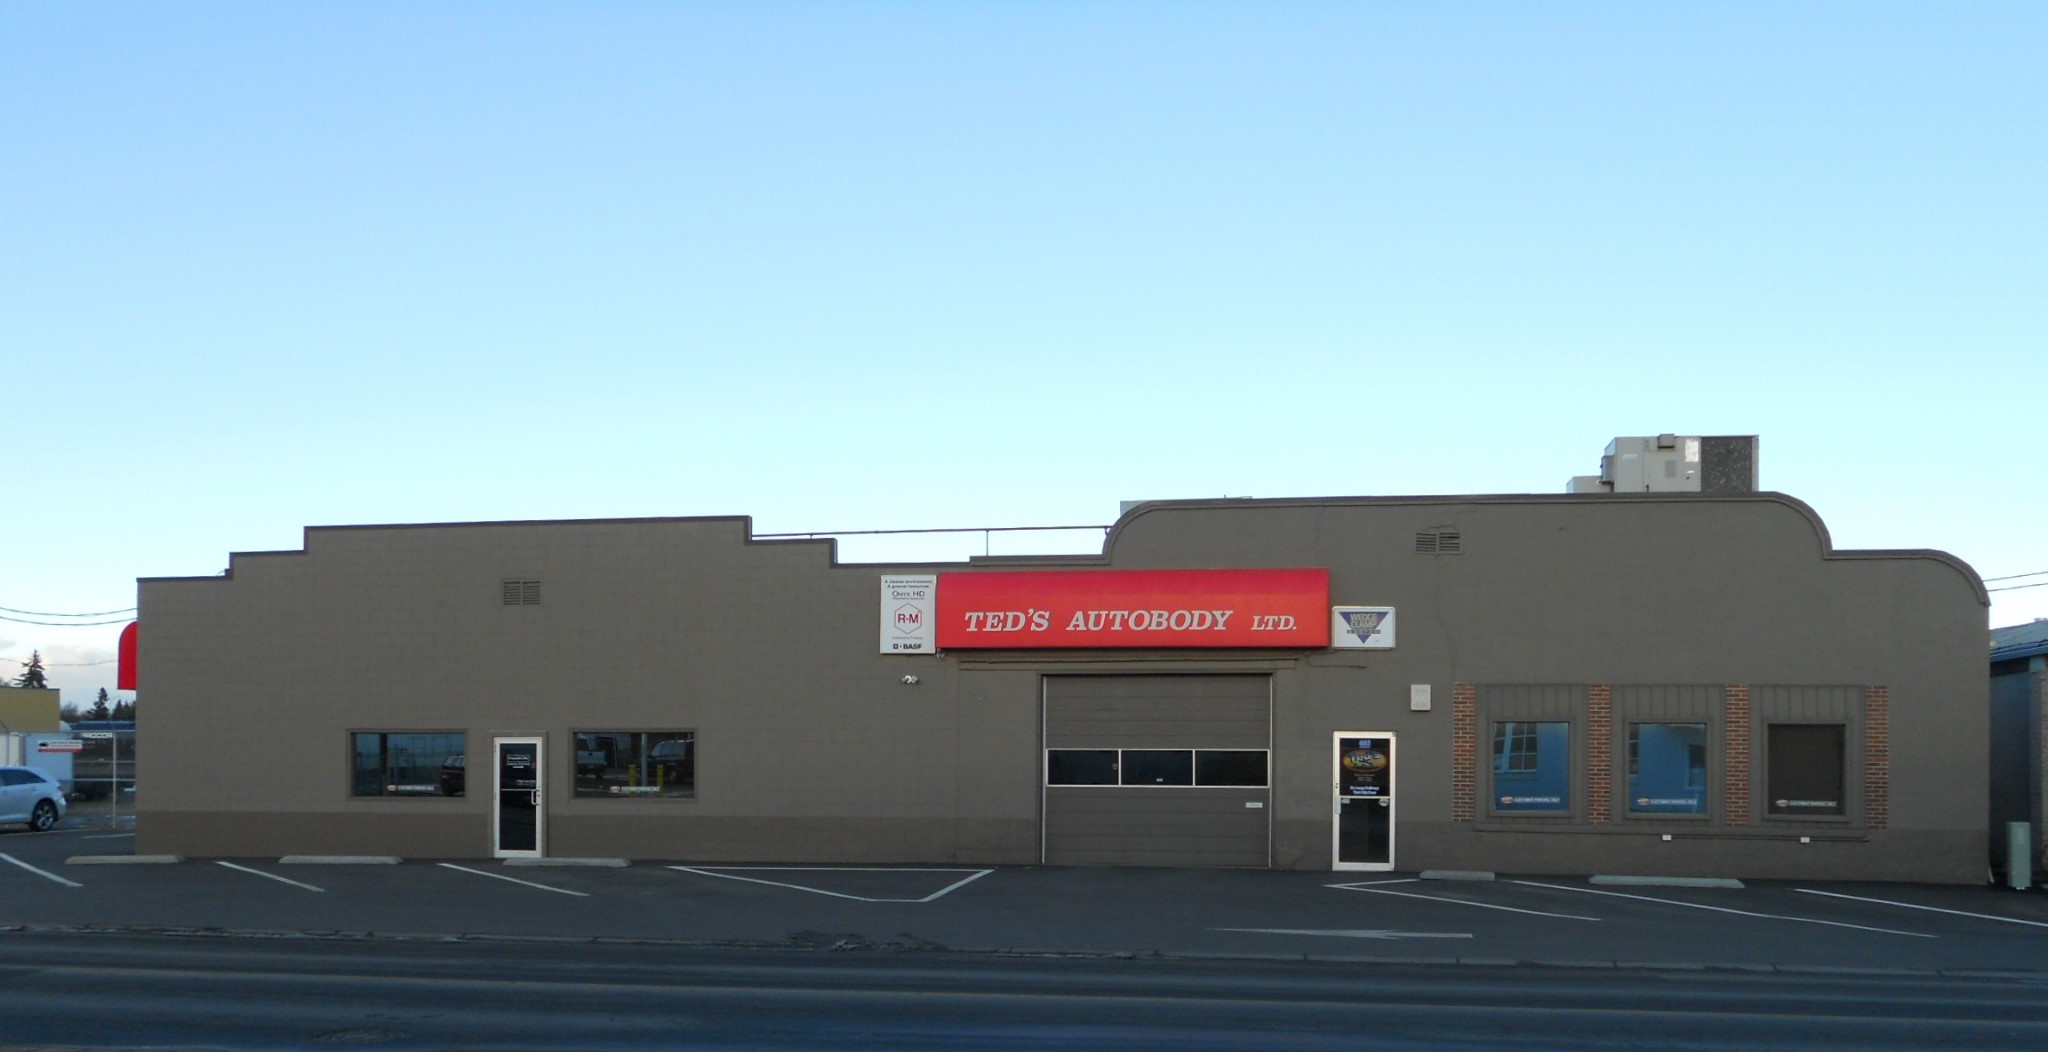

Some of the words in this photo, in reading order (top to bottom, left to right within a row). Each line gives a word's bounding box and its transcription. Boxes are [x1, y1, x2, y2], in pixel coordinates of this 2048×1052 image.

[965, 608, 1050, 632] TED'S
[1066, 610, 1234, 631] AUTOBODY
[1251, 615, 1297, 630] LTD.
[1350, 613, 1378, 621] WEDGE
[1351, 620, 1377, 629] CLAMP
